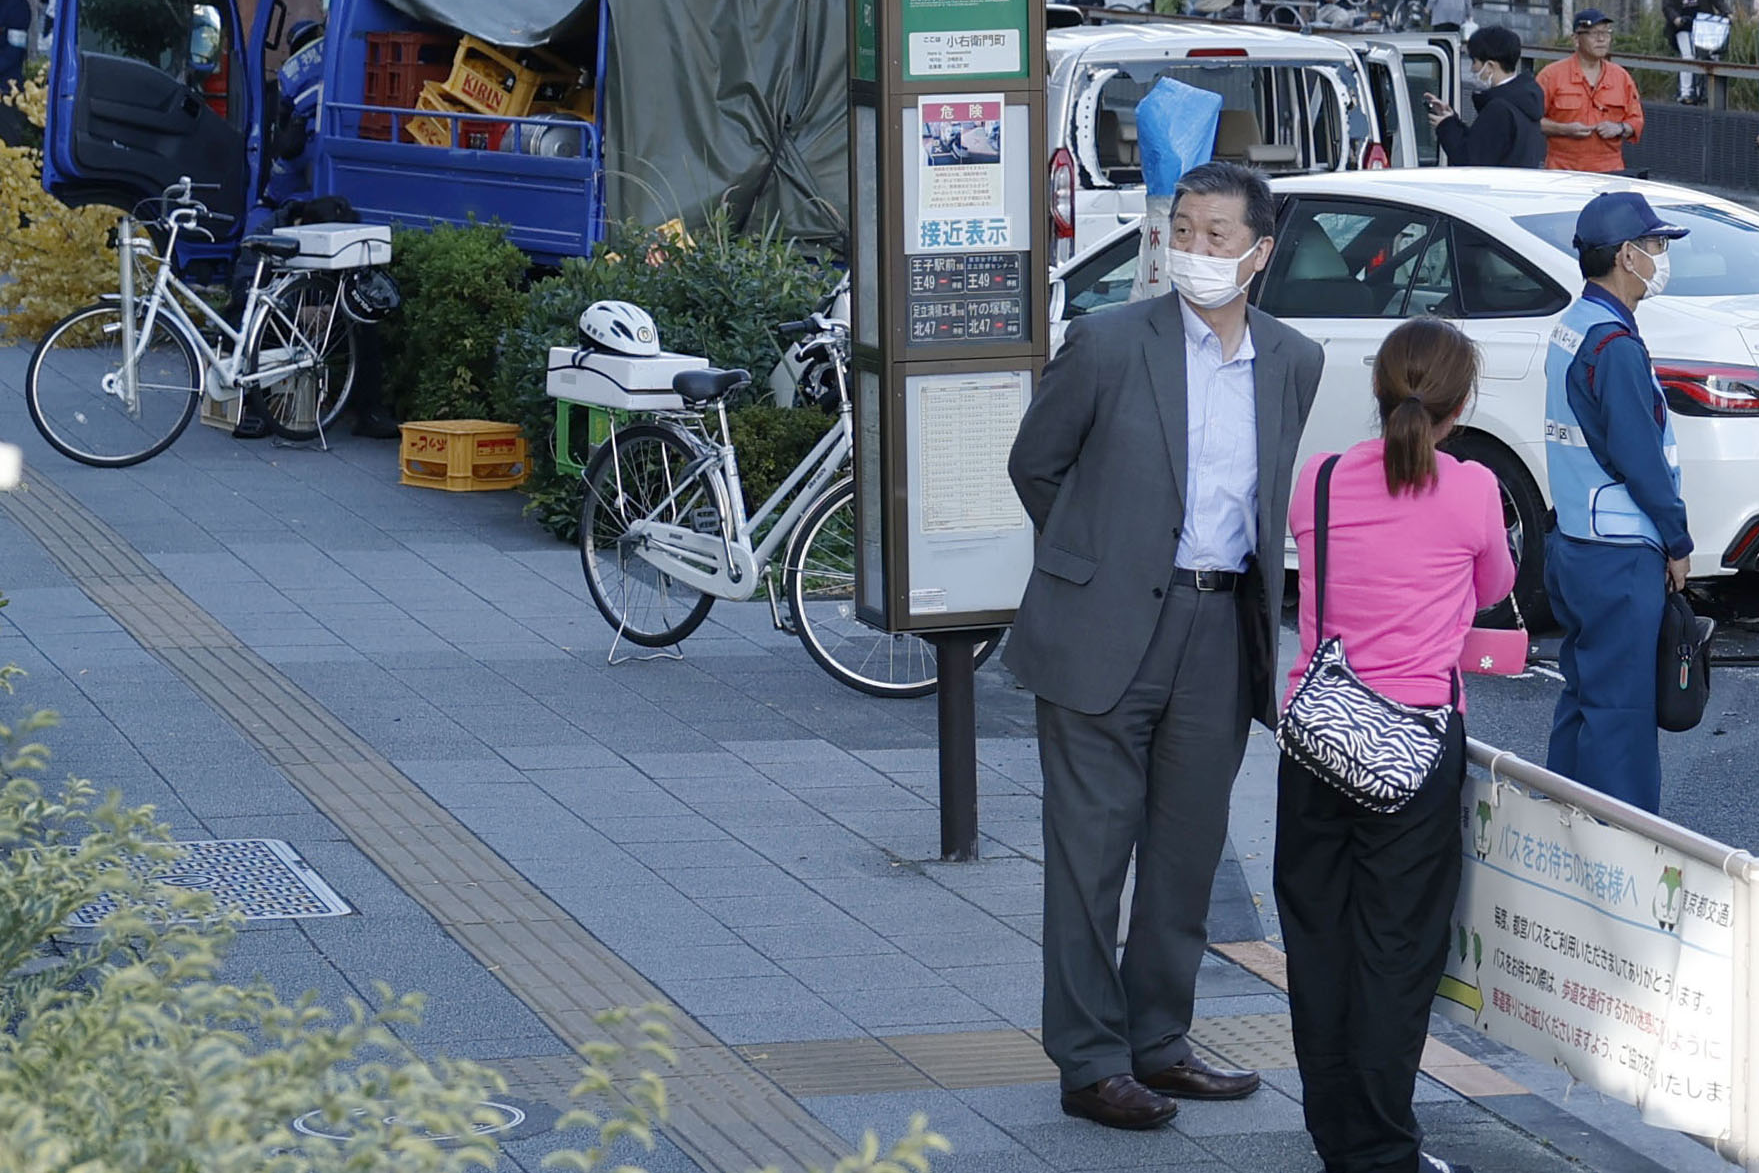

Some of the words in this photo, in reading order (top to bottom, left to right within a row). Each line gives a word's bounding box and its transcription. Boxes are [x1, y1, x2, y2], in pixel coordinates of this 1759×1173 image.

[946, 34, 1006, 48] 小右衛門町
[463, 73, 504, 108] KIRIN
[940, 104, 983, 120] 危険
[920, 218, 1008, 248] 接近表示
[1498, 822, 1639, 907] バスをお待ちのお客様へ
[1682, 889, 1734, 929] 東京都交通
